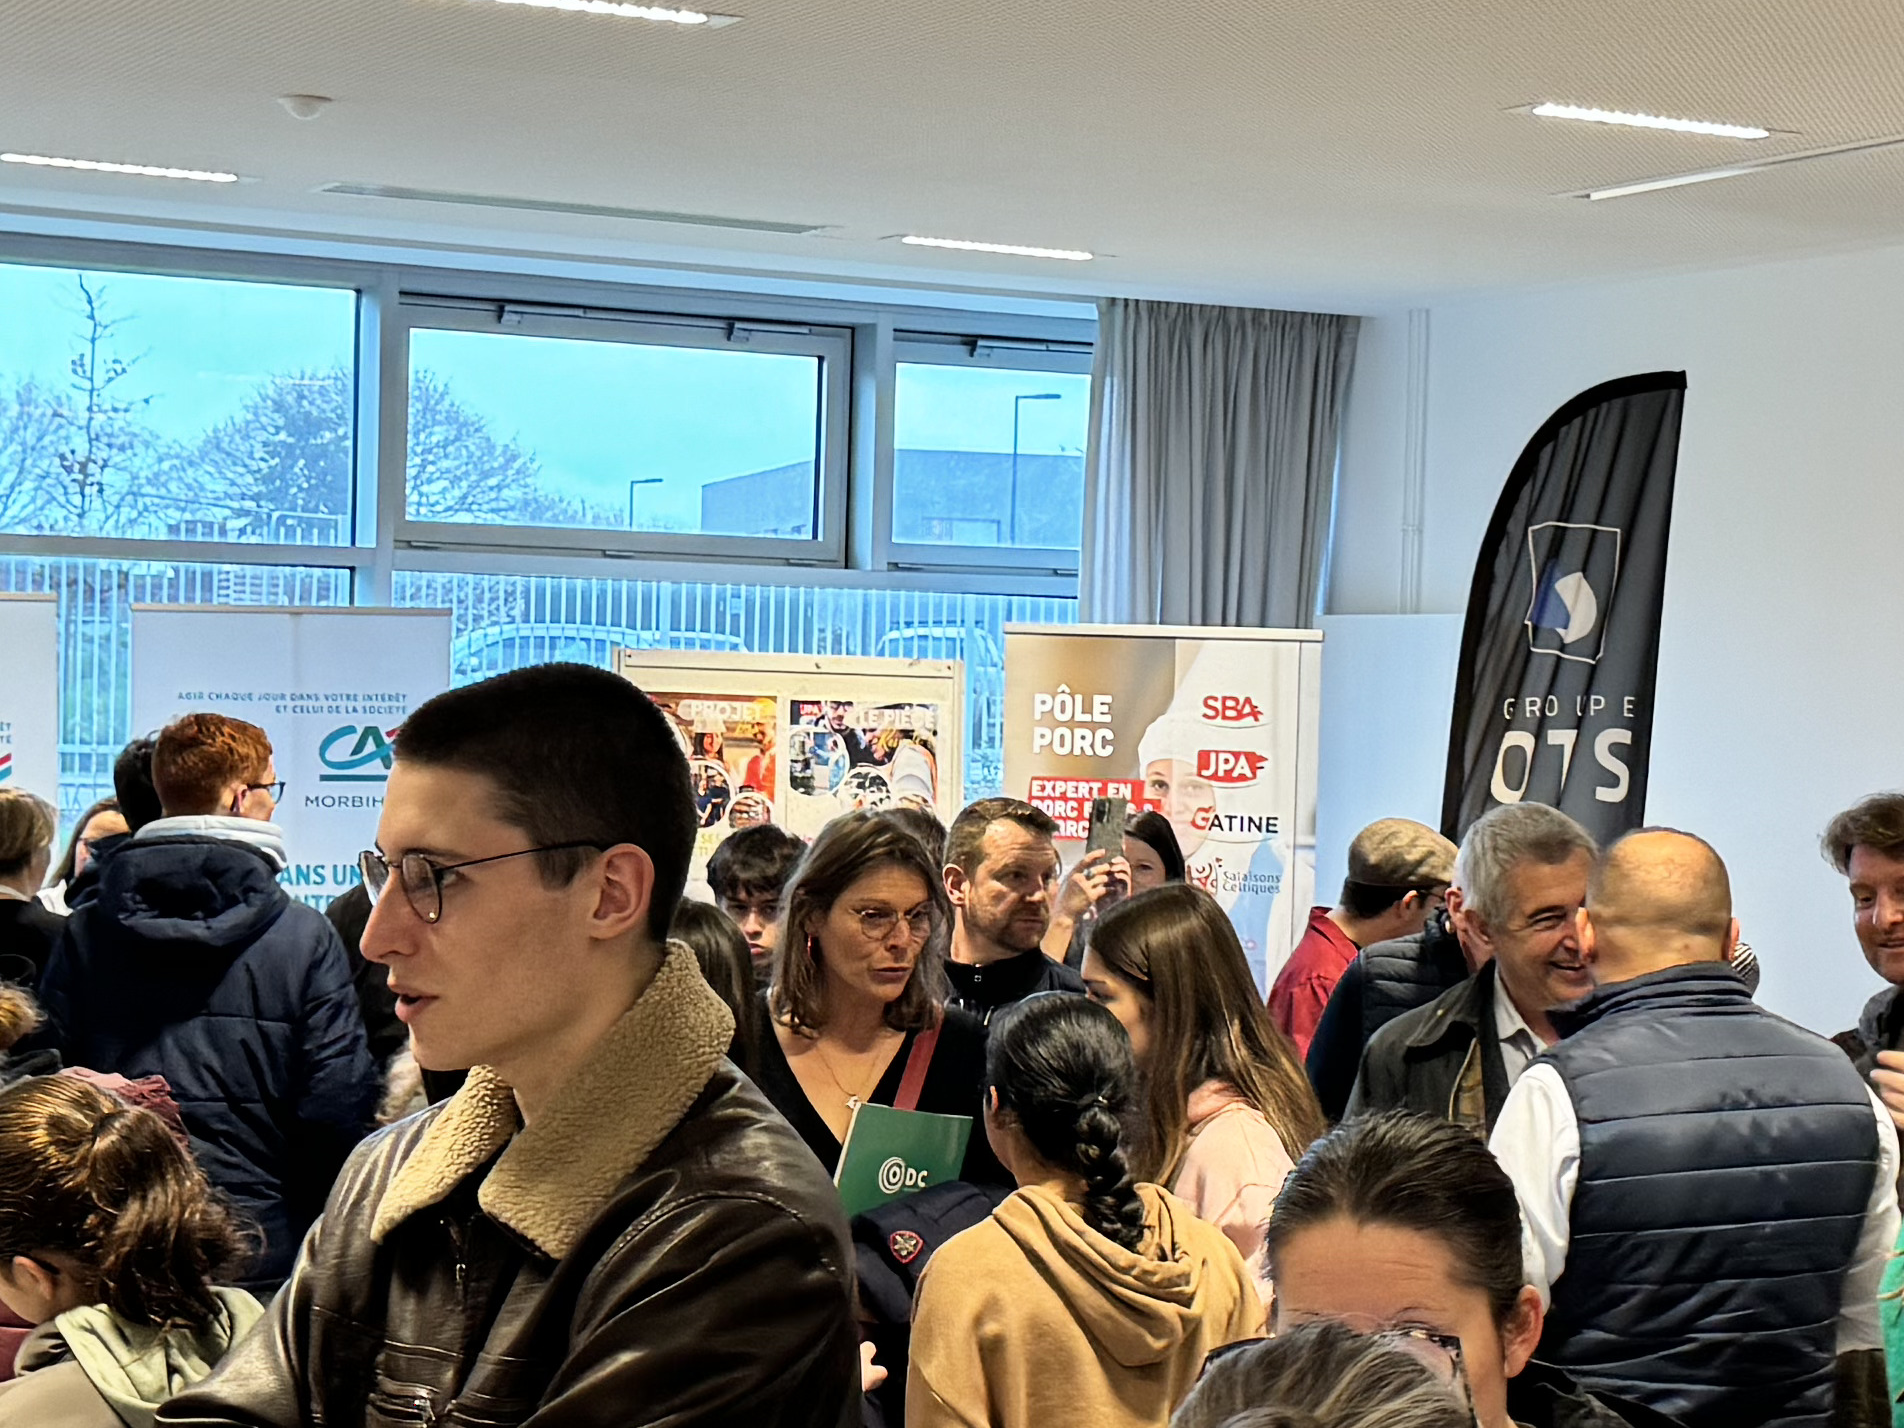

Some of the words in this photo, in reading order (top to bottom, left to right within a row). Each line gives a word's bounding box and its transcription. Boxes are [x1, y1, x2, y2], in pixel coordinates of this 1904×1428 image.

[208, 691, 253, 702] CHAQUE
[257, 692, 287, 702] JOUR
[289, 692, 320, 703] DANS
[324, 692, 358, 703] VOTRE
[1033, 683, 1114, 723] PÔLE
[1202, 695, 1264, 722] SBA
[1503, 695, 1636, 720] GROUPE
[275, 704, 288, 715] ET
[292, 704, 325, 715] CELUI
[327, 704, 341, 715] DE
[345, 704, 359, 715] LA
[691, 702, 761, 722] PROJET
[1033, 726, 1114, 758] PORC
[1200, 751, 1254, 779] JPA
[1490, 728, 1632, 804] OTS
[305, 794, 385, 808] MORBIH
[1031, 780, 1102, 799] EXPERT
[1108, 783, 1132, 800] EN
[1191, 806, 1279, 834] GATINE
[279, 864, 326, 886] ANS
[1223, 871, 1281, 883] Salaisons
[1222, 882, 1281, 895] Celtiques
[878, 1156, 928, 1194] ODC
